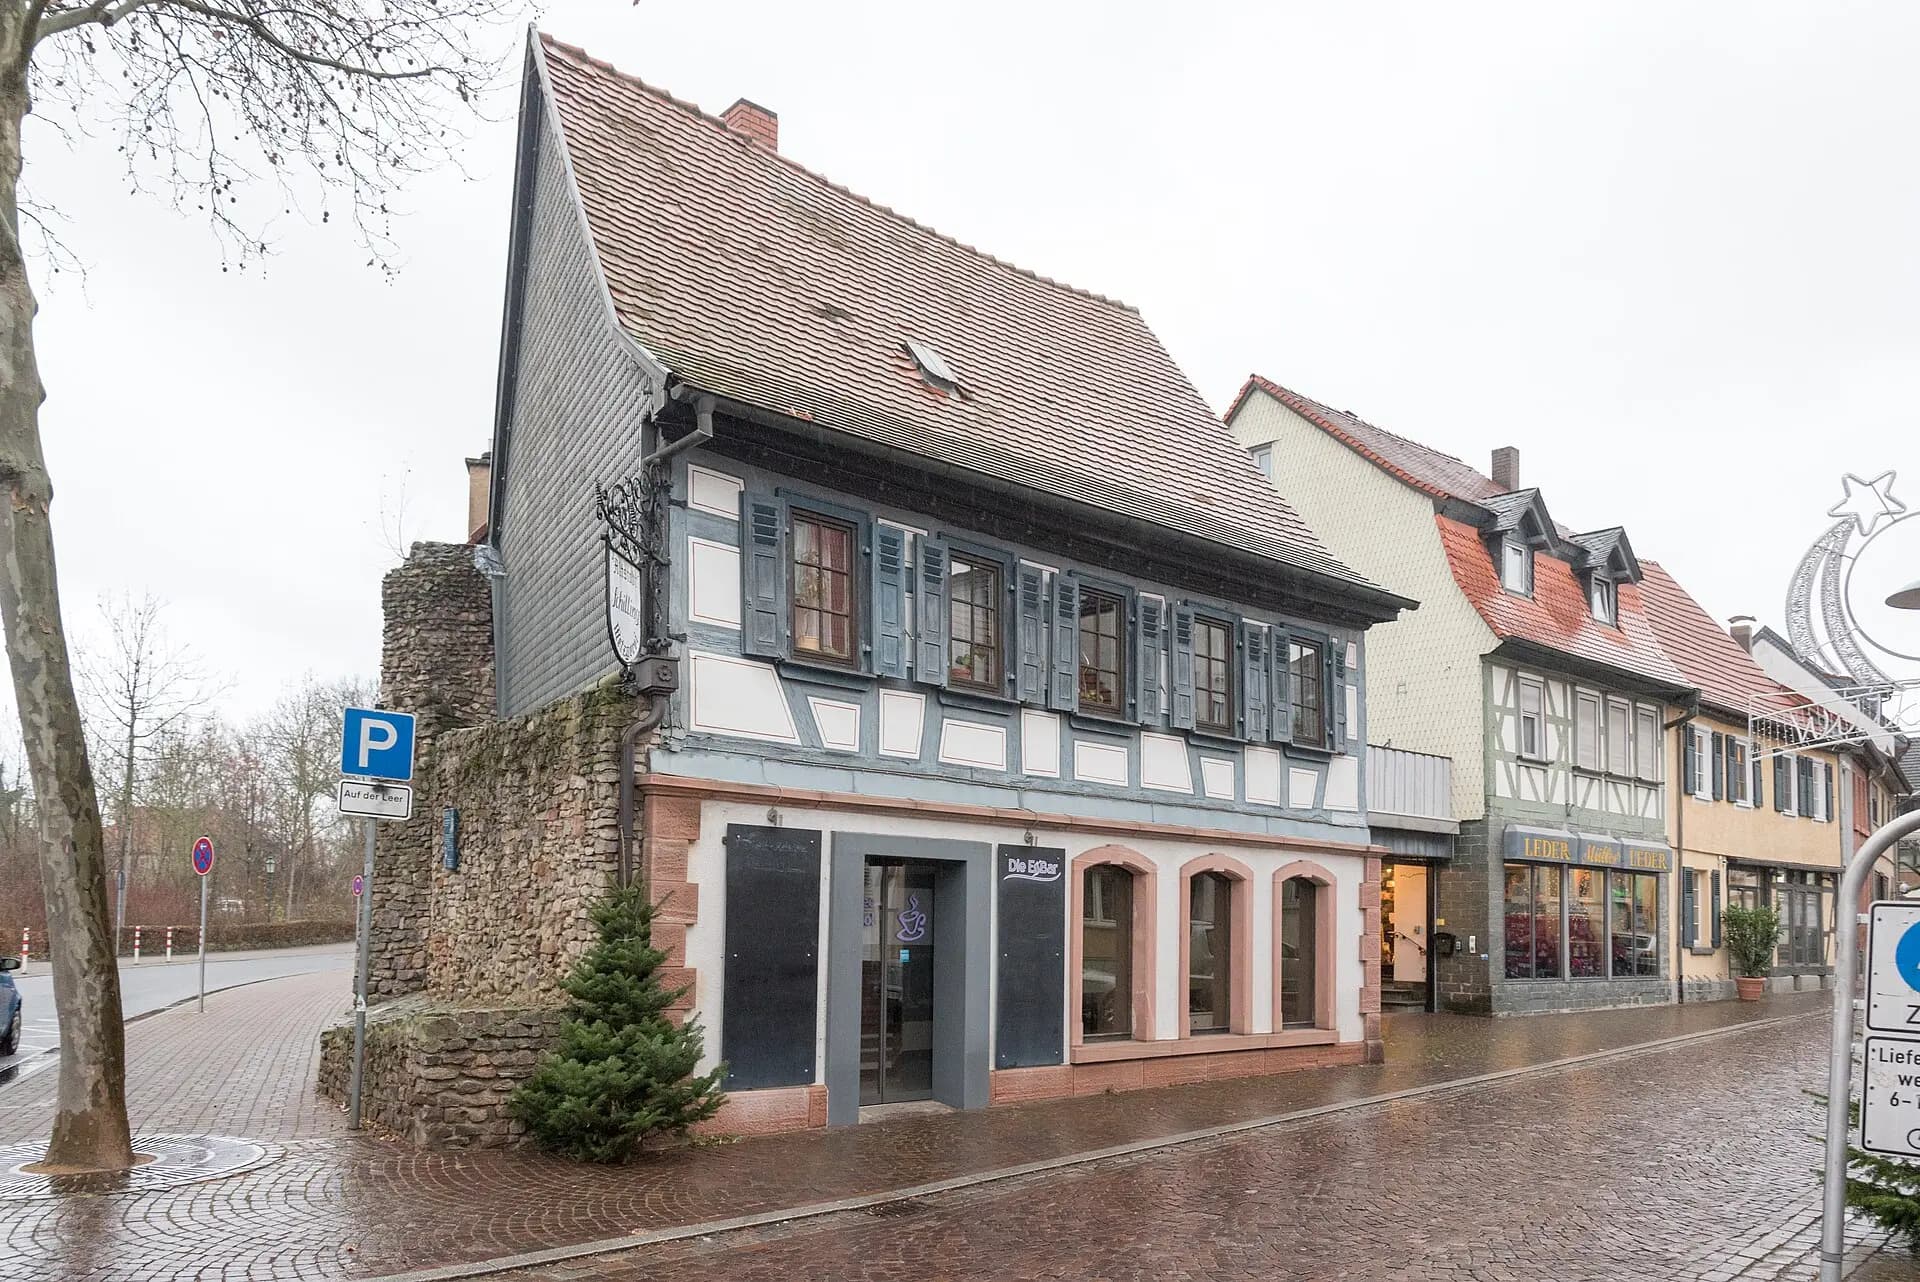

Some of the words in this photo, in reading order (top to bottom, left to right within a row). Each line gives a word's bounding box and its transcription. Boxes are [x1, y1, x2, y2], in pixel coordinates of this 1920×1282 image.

[358, 717, 398, 768] P
[344, 789, 361, 800] Auf
[363, 791, 380, 802] der
[382, 792, 404, 805] Leer
[1524, 837, 1571, 861] LEDER
[1629, 847, 1668, 870] LEDER
[1008, 858, 1027, 873] Die
